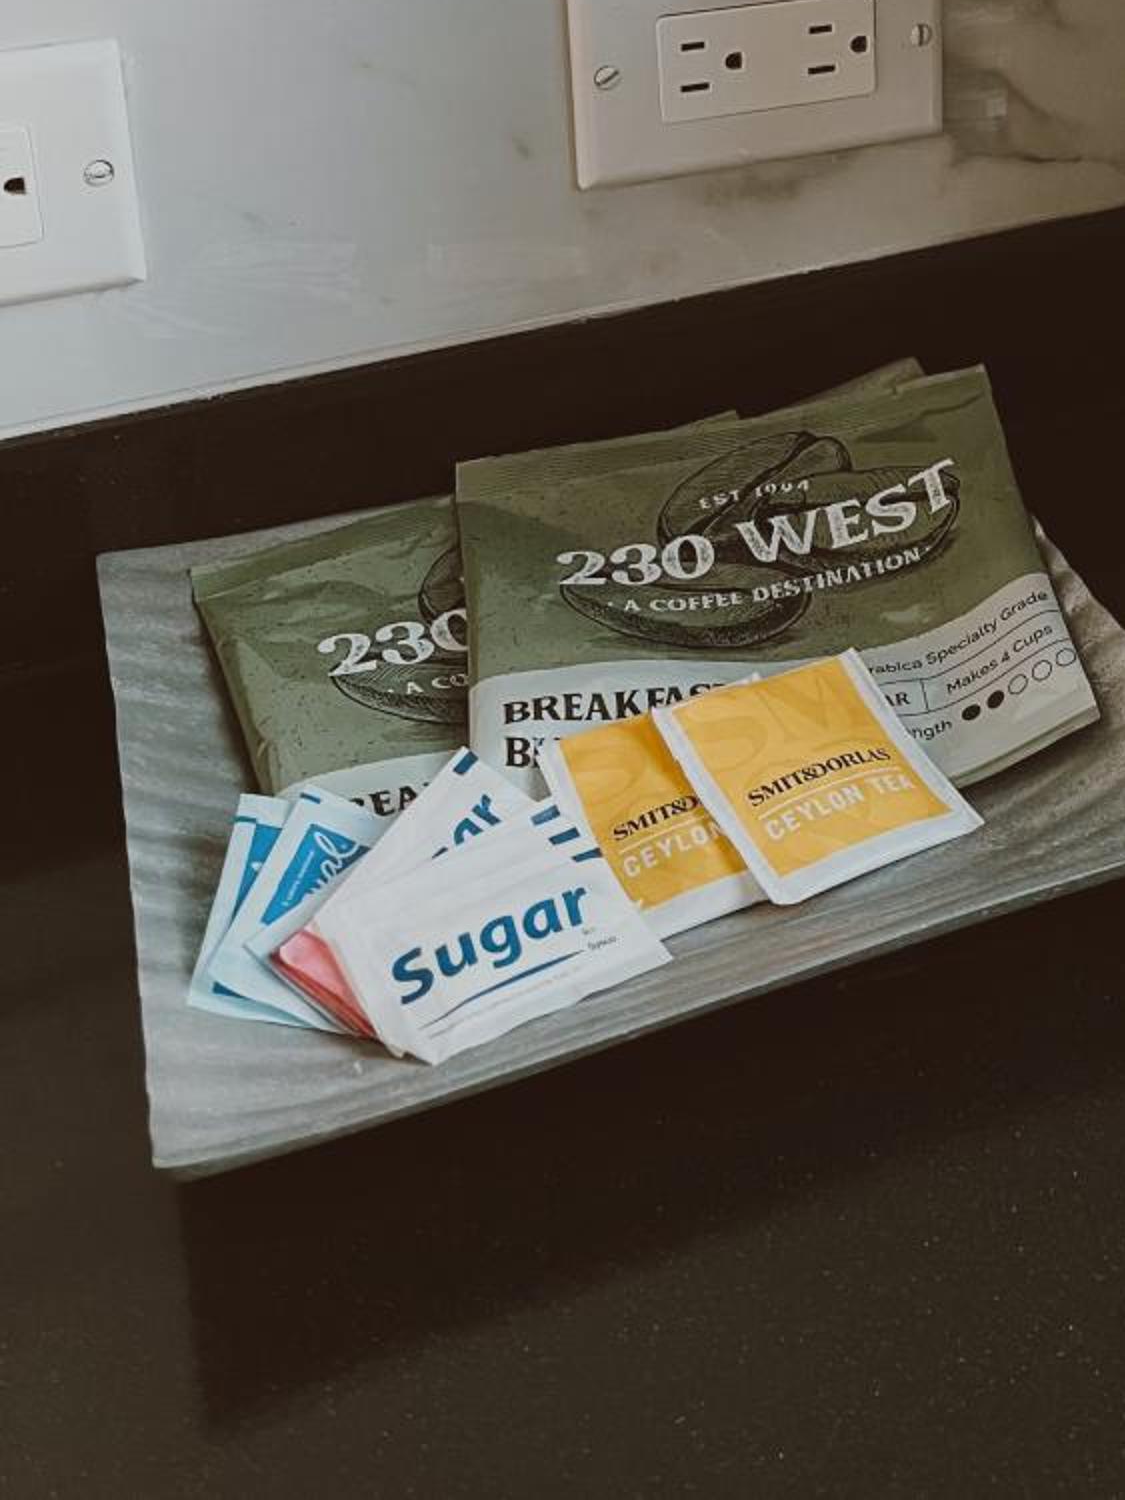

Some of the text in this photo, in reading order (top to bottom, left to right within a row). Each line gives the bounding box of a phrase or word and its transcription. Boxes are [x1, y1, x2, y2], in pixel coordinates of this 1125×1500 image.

[555, 458, 957, 586] 230 WEST
[623, 548, 922, 613] A COFFEE DESTINATION
[317, 608, 469, 677] 230
[868, 589, 1049, 677] rabica Specialty Grade
[946, 624, 1054, 694] Makes 4 Cups
[502, 683, 725, 725] BREAKFA
[911, 719, 953, 741] ngth
[746, 747, 891, 807] SMIT&DORLAS
[765, 774, 917, 842] CEYLON TEA
[613, 794, 703, 842] SMIT&D
[391, 887, 587, 1005] Sugar
